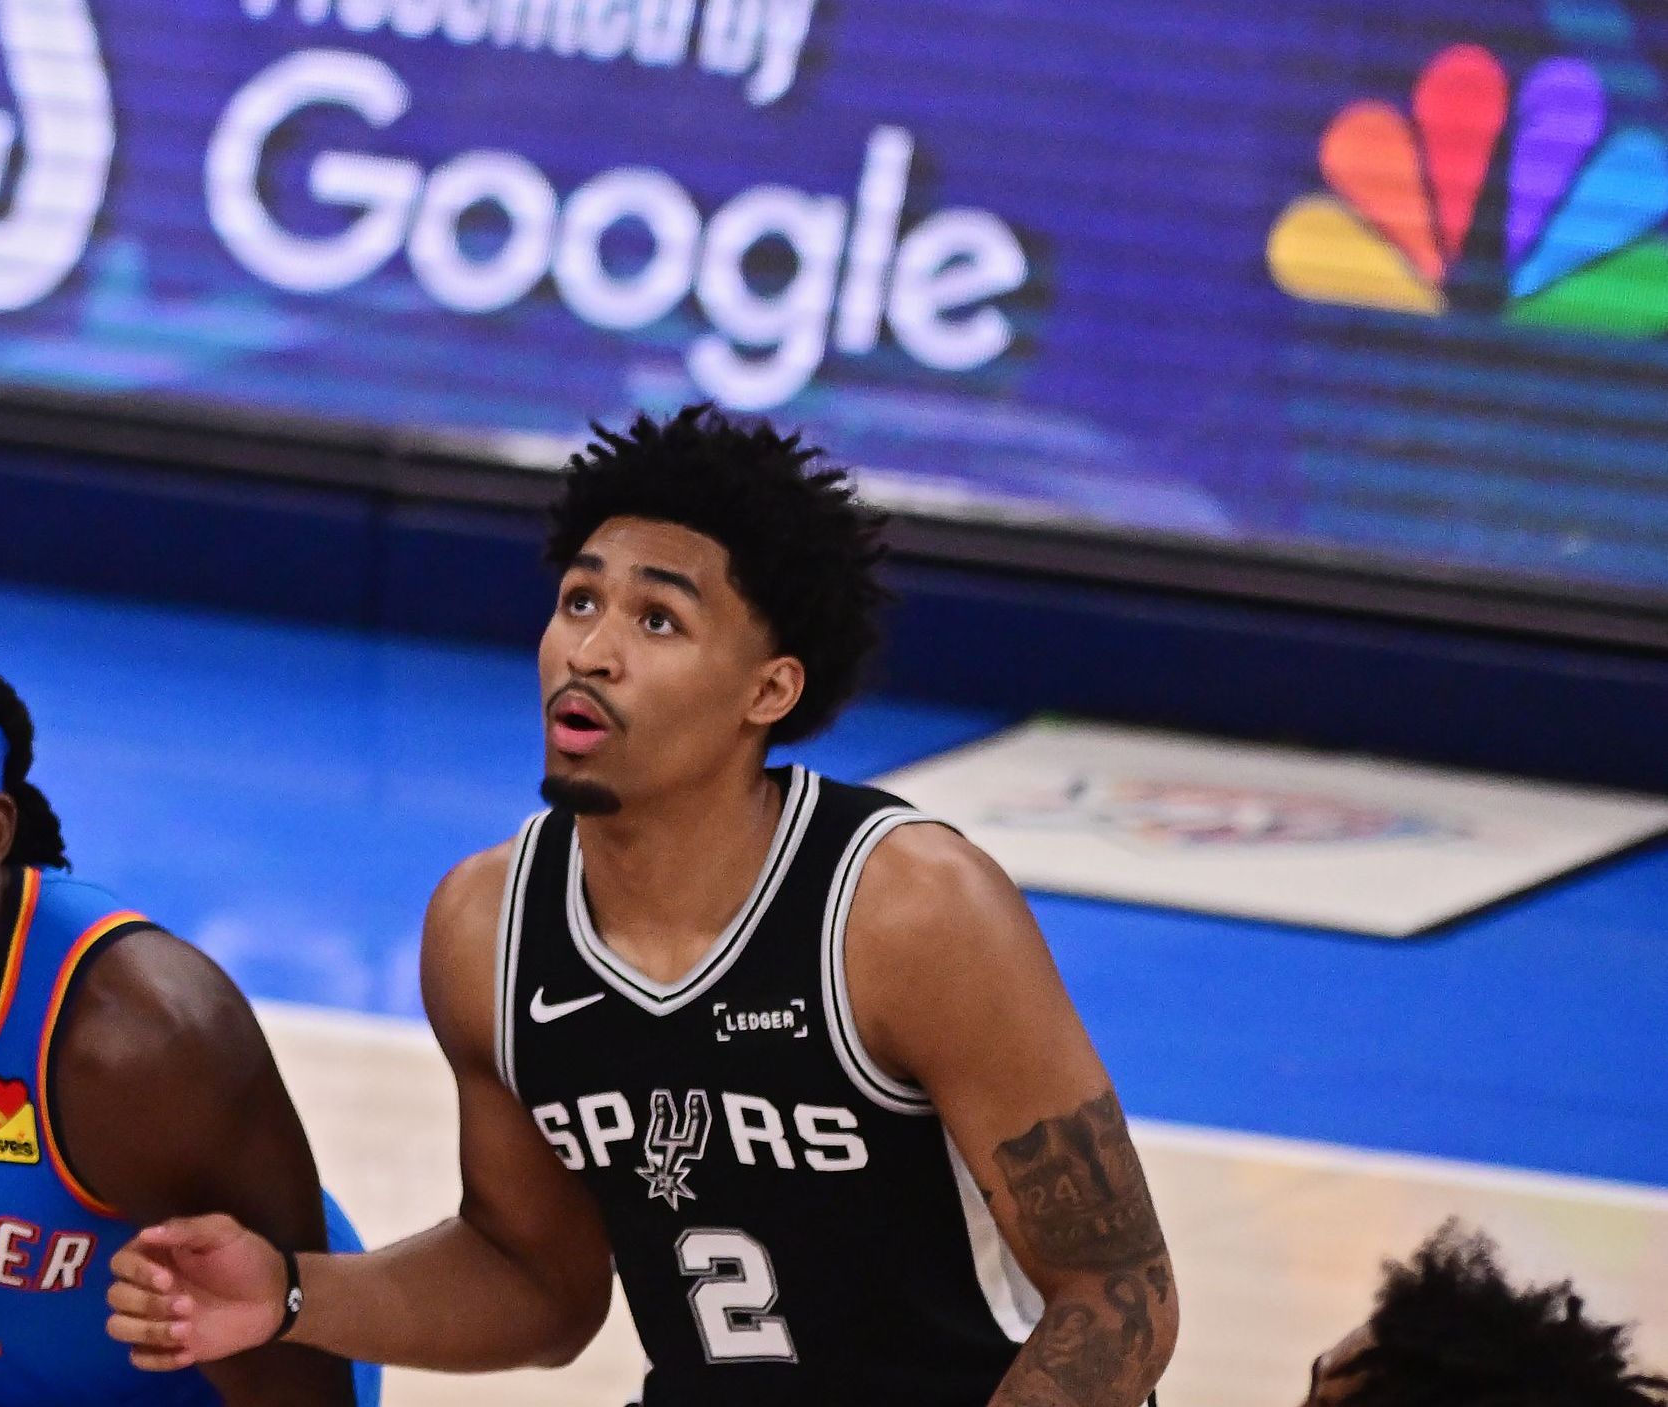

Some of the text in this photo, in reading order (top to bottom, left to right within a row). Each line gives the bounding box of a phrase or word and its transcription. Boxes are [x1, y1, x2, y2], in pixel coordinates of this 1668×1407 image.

[204, 48, 1030, 411] Google
[725, 1009, 795, 1032] LEDGER
[532, 1088, 869, 1210] SPURS
[673, 1227, 798, 1365] 2
